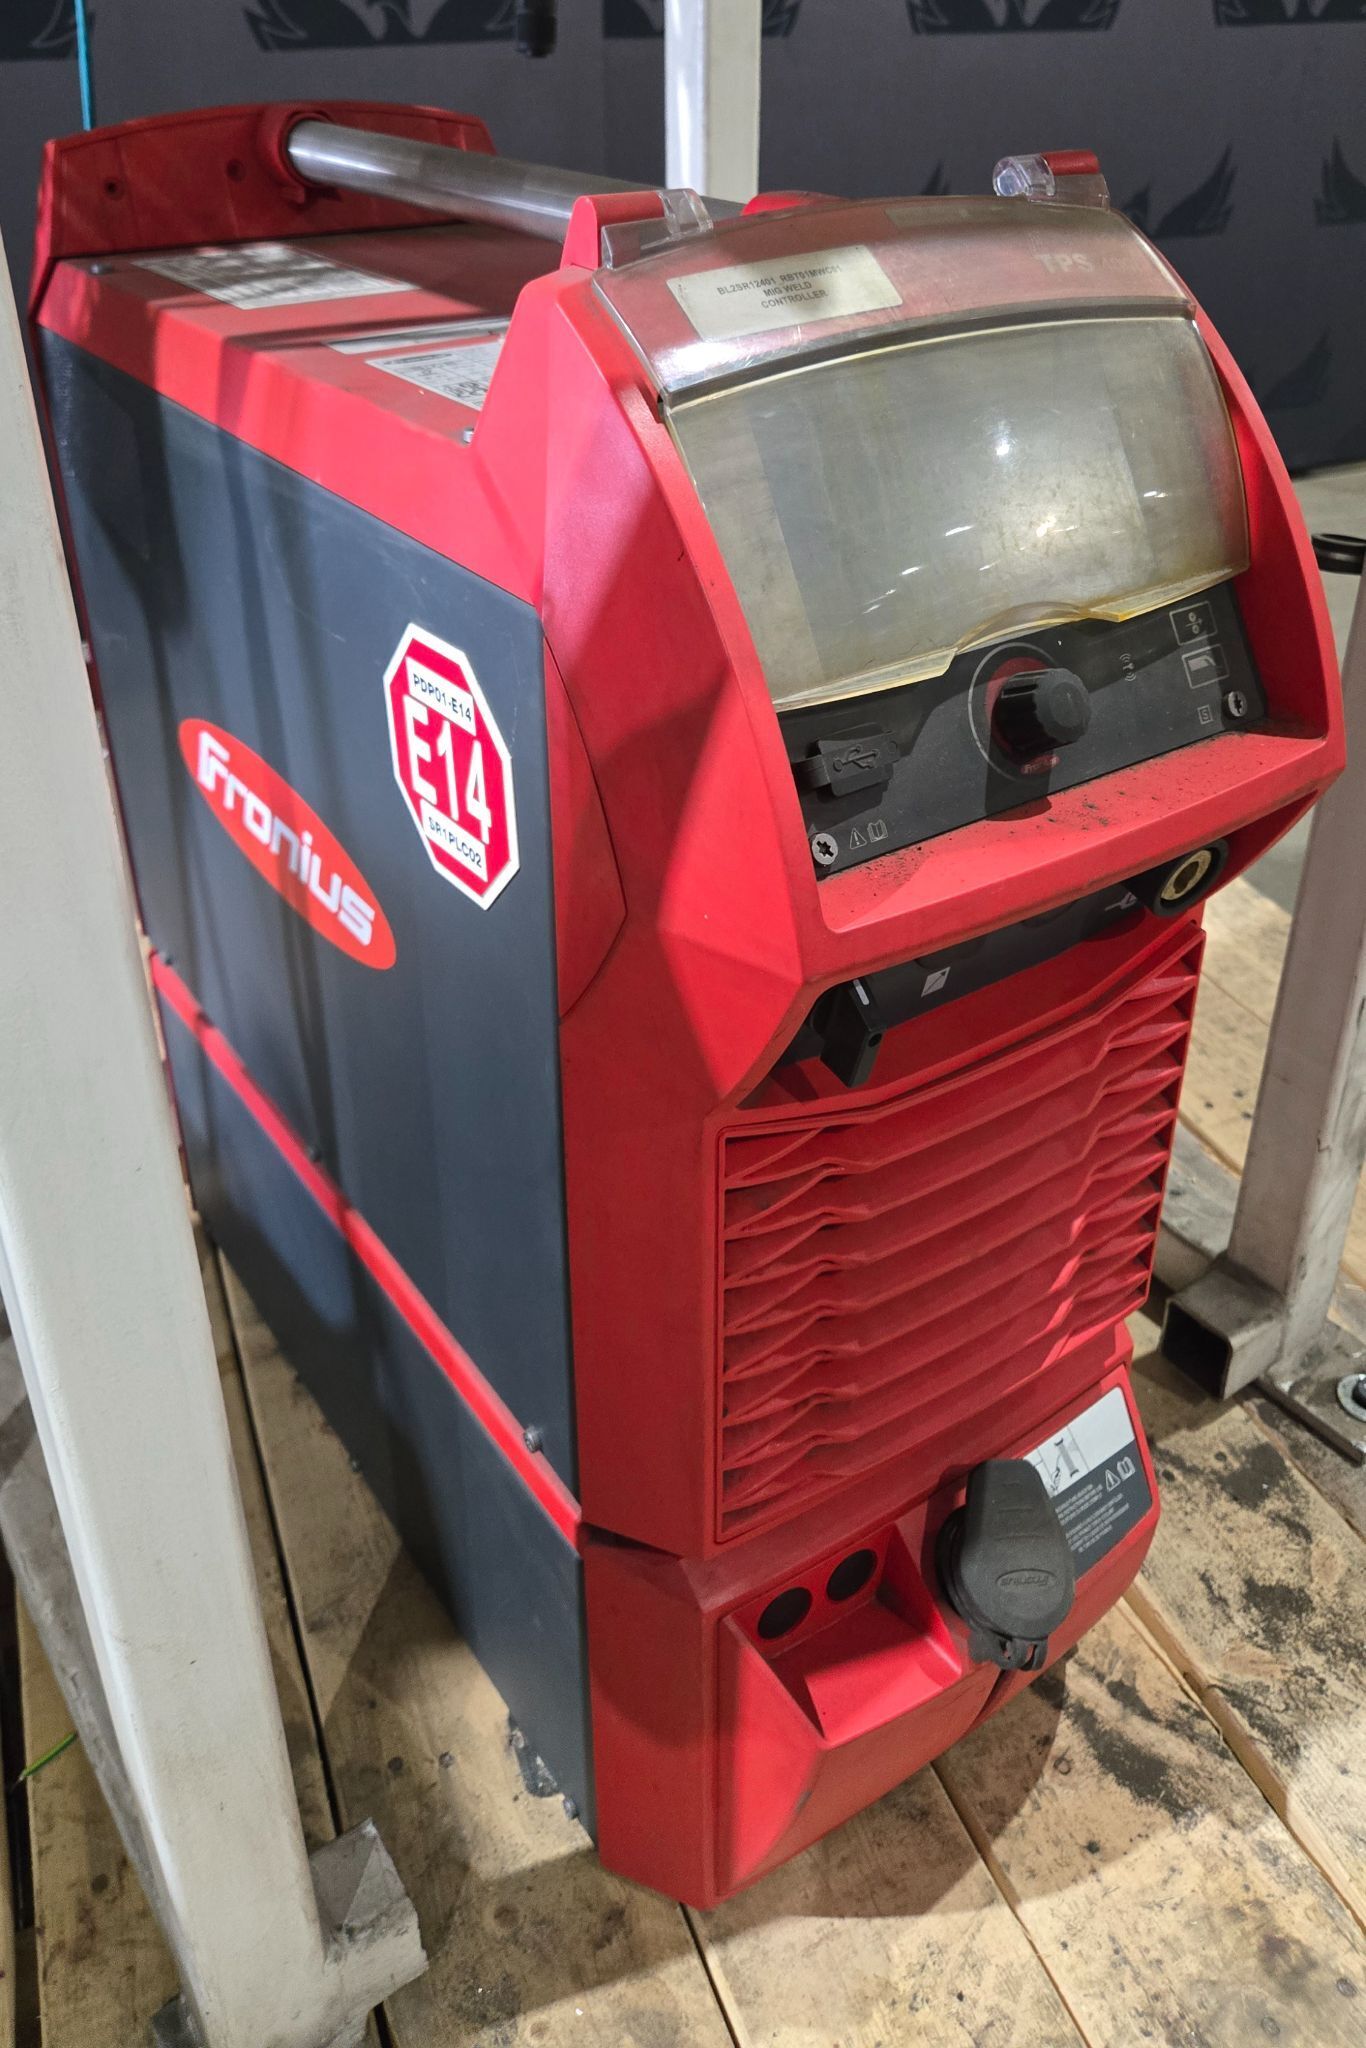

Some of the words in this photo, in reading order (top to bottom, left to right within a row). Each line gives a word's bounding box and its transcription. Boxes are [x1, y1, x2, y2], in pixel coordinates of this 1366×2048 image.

[1035, 252, 1094, 273] TPS
[760, 289, 829, 309] CONTROLLER
[763, 286, 783, 298] MIG
[784, 281, 812, 294] WELD
[413, 673, 472, 722] PDP01-E14
[403, 694, 492, 845] E14
[197, 730, 376, 947] Fronius
[428, 817, 482, 868] SR1PLC02
